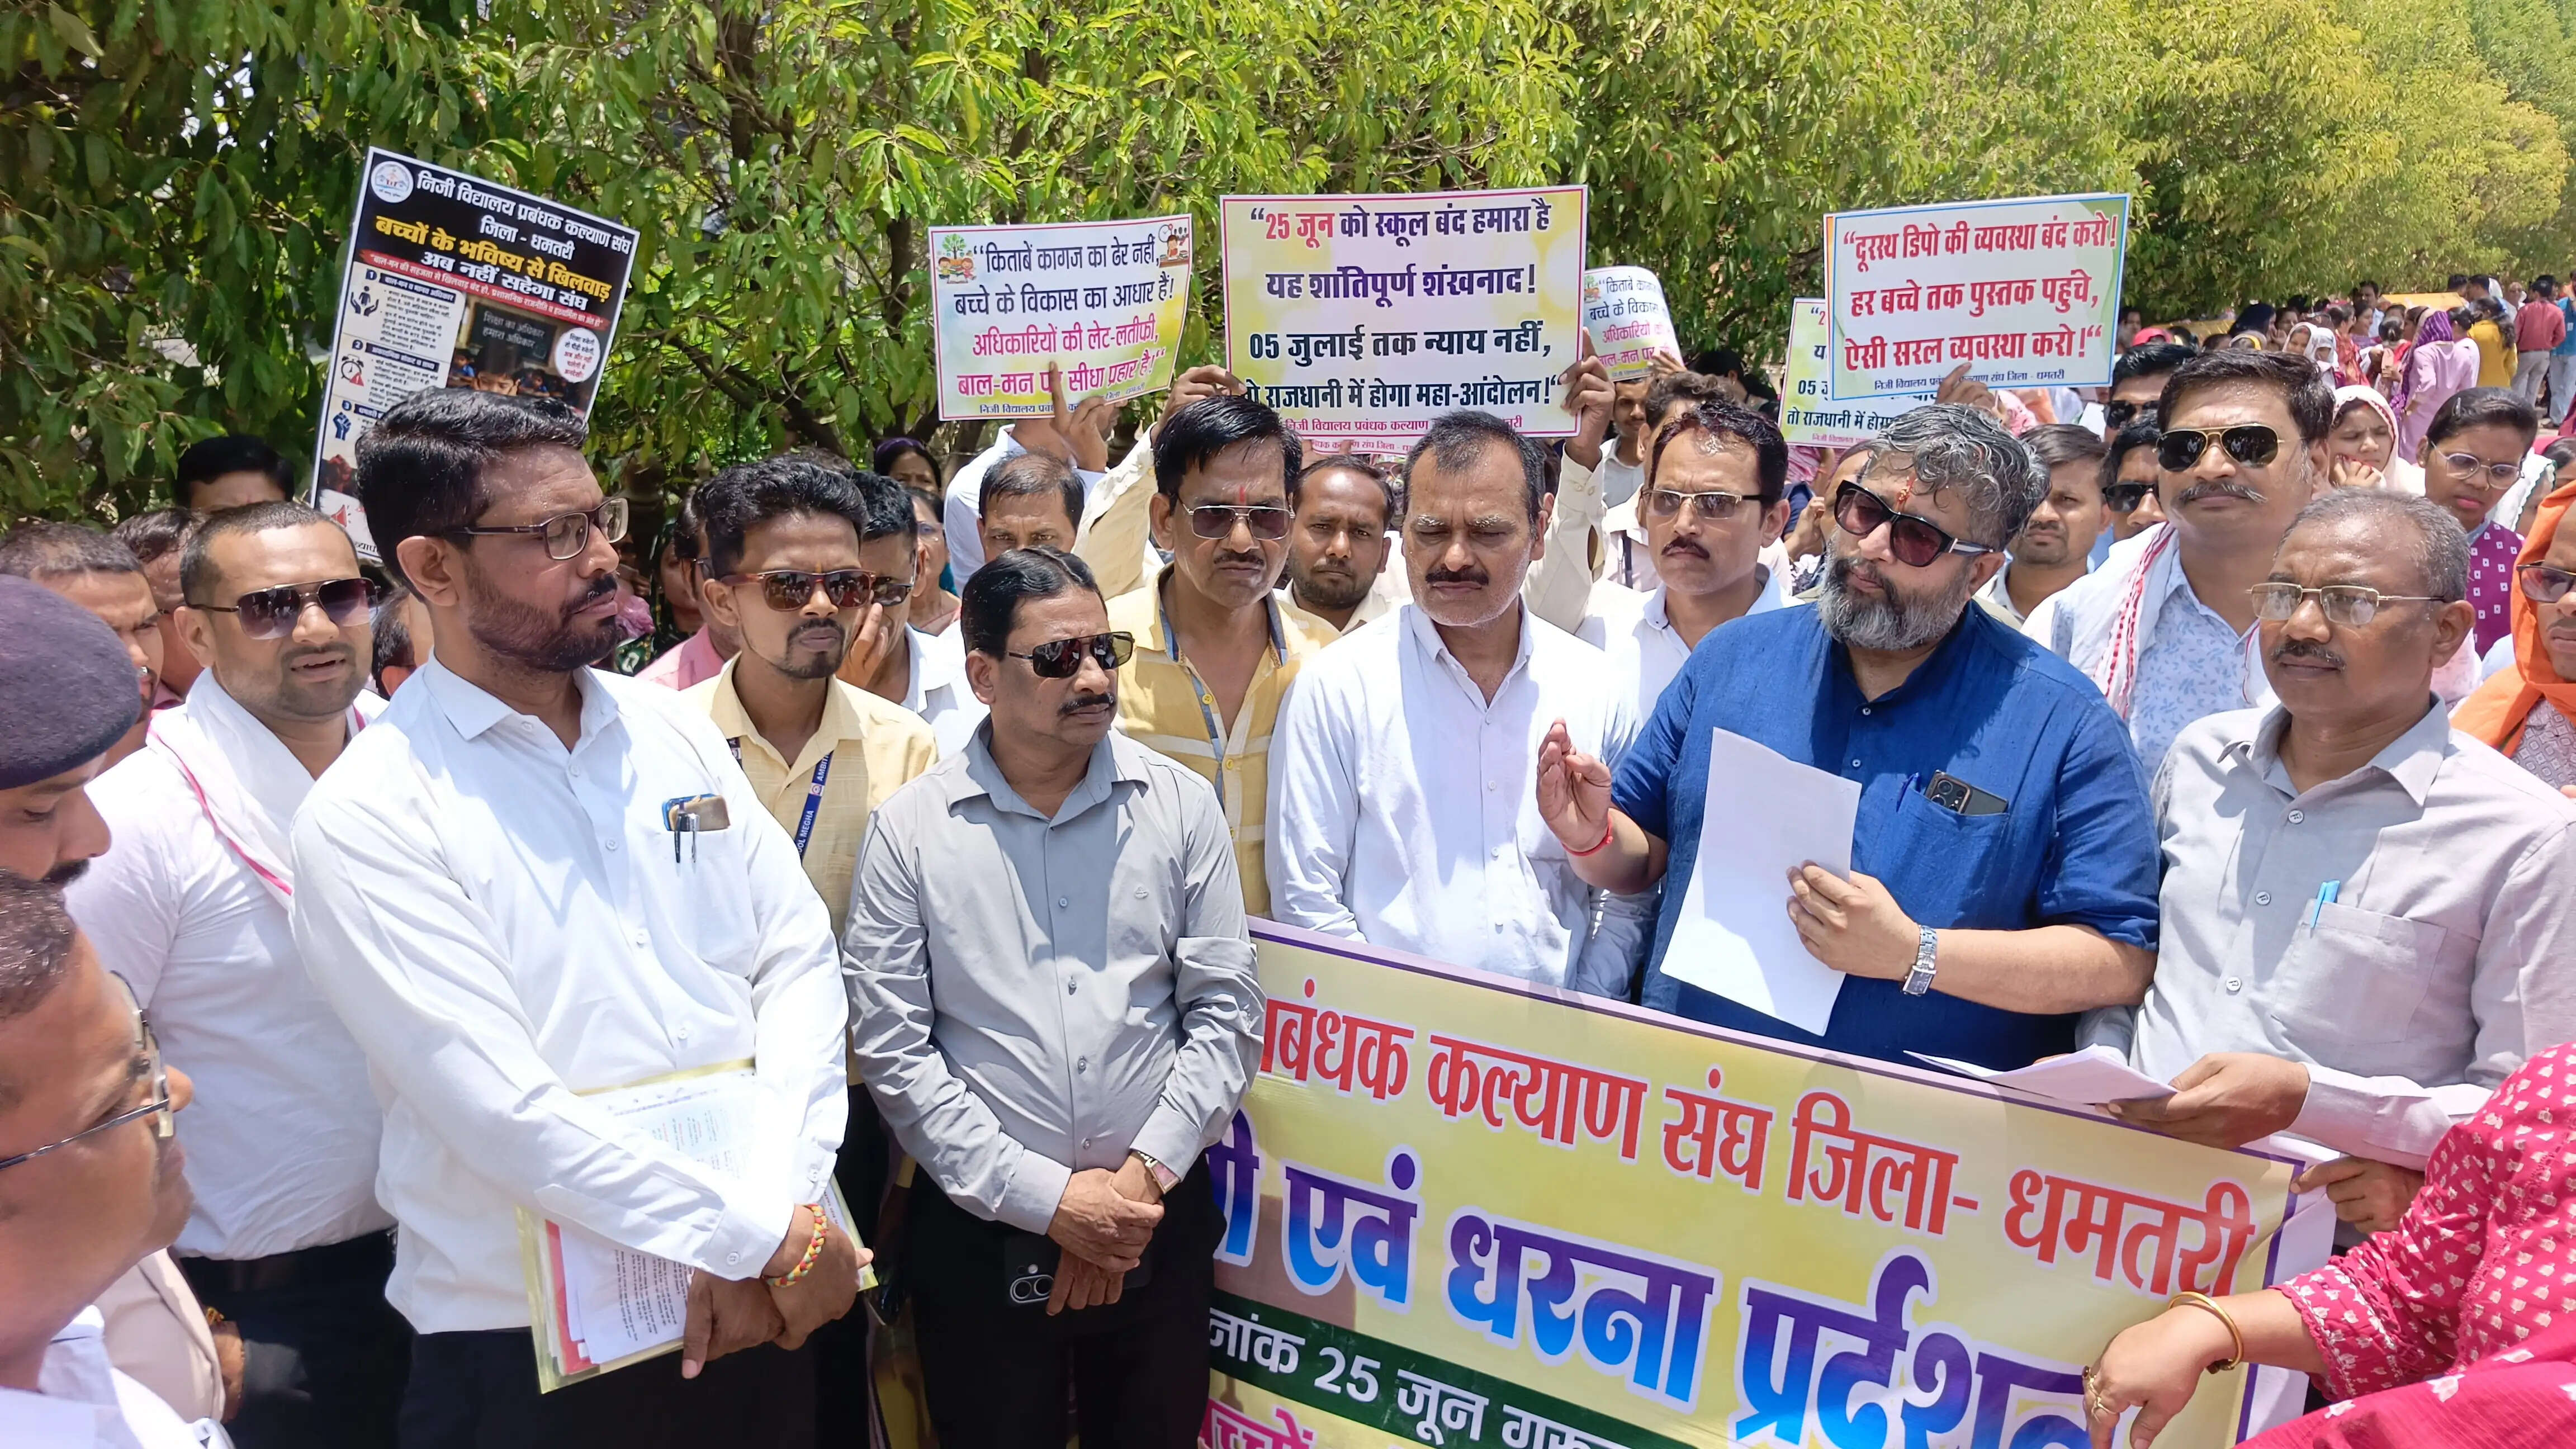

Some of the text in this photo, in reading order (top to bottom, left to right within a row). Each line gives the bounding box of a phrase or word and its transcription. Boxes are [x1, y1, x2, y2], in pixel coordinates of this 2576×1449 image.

[417, 170, 632, 254] निजी विद्यालय प्रबंधक कल्याण संघ
[1296, 213, 1334, 249] जून
[1340, 205, 1370, 238] को
[1375, 211, 1430, 247] स्कूल
[1434, 203, 1467, 236] बंद
[1472, 206, 1532, 234] हमारा
[1532, 197, 1552, 231] है
[480, 215, 518, 242] जिला
[531, 234, 576, 261] धमतरी
[1037, 246, 1083, 272] कागज
[1087, 245, 1107, 268] का
[1111, 236, 1129, 266] ढेर
[1132, 233, 1159, 267] नहीं,
[1902, 222, 1940, 259] डिपो
[1945, 220, 1969, 255] की
[1974, 224, 2038, 253] व्यवस्था
[2042, 215, 2069, 248] बंद
[2073, 211, 2117, 248] करो!
[376, 215, 612, 302] बच्चों के भविष्य से खिलवाड़
[420, 252, 588, 311] अब नहीं सहेगा संघ
[954, 285, 990, 316] बच्चे
[995, 283, 1016, 315] के
[1020, 282, 1078, 314] विकास
[1083, 286, 1107, 310] का
[1113, 281, 1155, 307] आधार
[1265, 273, 1305, 299] यह
[1309, 263, 1417, 308] शांतिपूर्ण
[1850, 290, 1877, 317] हर
[1881, 279, 1922, 314] बच्चे
[1926, 283, 1965, 310] तक
[1968, 279, 2037, 318] पुस्तक
[1589, 301, 1609, 320] बच्चे
[1613, 299, 1624, 316] के
[972, 312, 1159, 357] अधिकारियों की लेट-लतीफी,
[1249, 320, 1551, 367] 05 जुलाई तक न्याय नहीं,
[1845, 335, 1887, 371] ऐसी
[1893, 337, 1945, 366] सरल
[1949, 330, 2027, 362] व्यवस्था
[956, 372, 1034, 396] बाल-मन
[1040, 371, 1062, 394] प
[1068, 362, 1105, 392] सीधा
[1107, 359, 1138, 388] प्रहार
[1265, 378, 1343, 409] राजधानी
[1348, 378, 1365, 408] में
[1369, 378, 1412, 408] होगा
[1798, 380, 1816, 395] 05
[1874, 380, 1893, 390] निजी
[1896, 378, 1926, 389] विद्यालय
[1991, 372, 2005, 382] संघ
[2007, 371, 2028, 381] जिला
[2037, 369, 2064, 380] धमतरी
[979, 404, 1000, 414] निजी
[1002, 404, 1035, 413] विद्यालय
[1313, 419, 1351, 430] विद्यालय
[1355, 419, 1387, 430] प्रबंधक
[1390, 420, 1428, 430] कल्याण
[1787, 407, 1800, 425] तो
[1803, 410, 1851, 429] राजधानी
[1854, 411, 1866, 429] में
[801, 809, 815, 837] MEGHA
[1428, 1034, 1649, 1161] कल्याण
[1663, 1067, 1773, 1191] संघ
[2004, 1180, 2256, 1296] धमतरी
[1285, 1152, 1418, 1305] एवं
[1447, 1213, 1715, 1404] धरना
[1313, 1346, 1381, 1402] 25
[1397, 1367, 1490, 1446] जून
